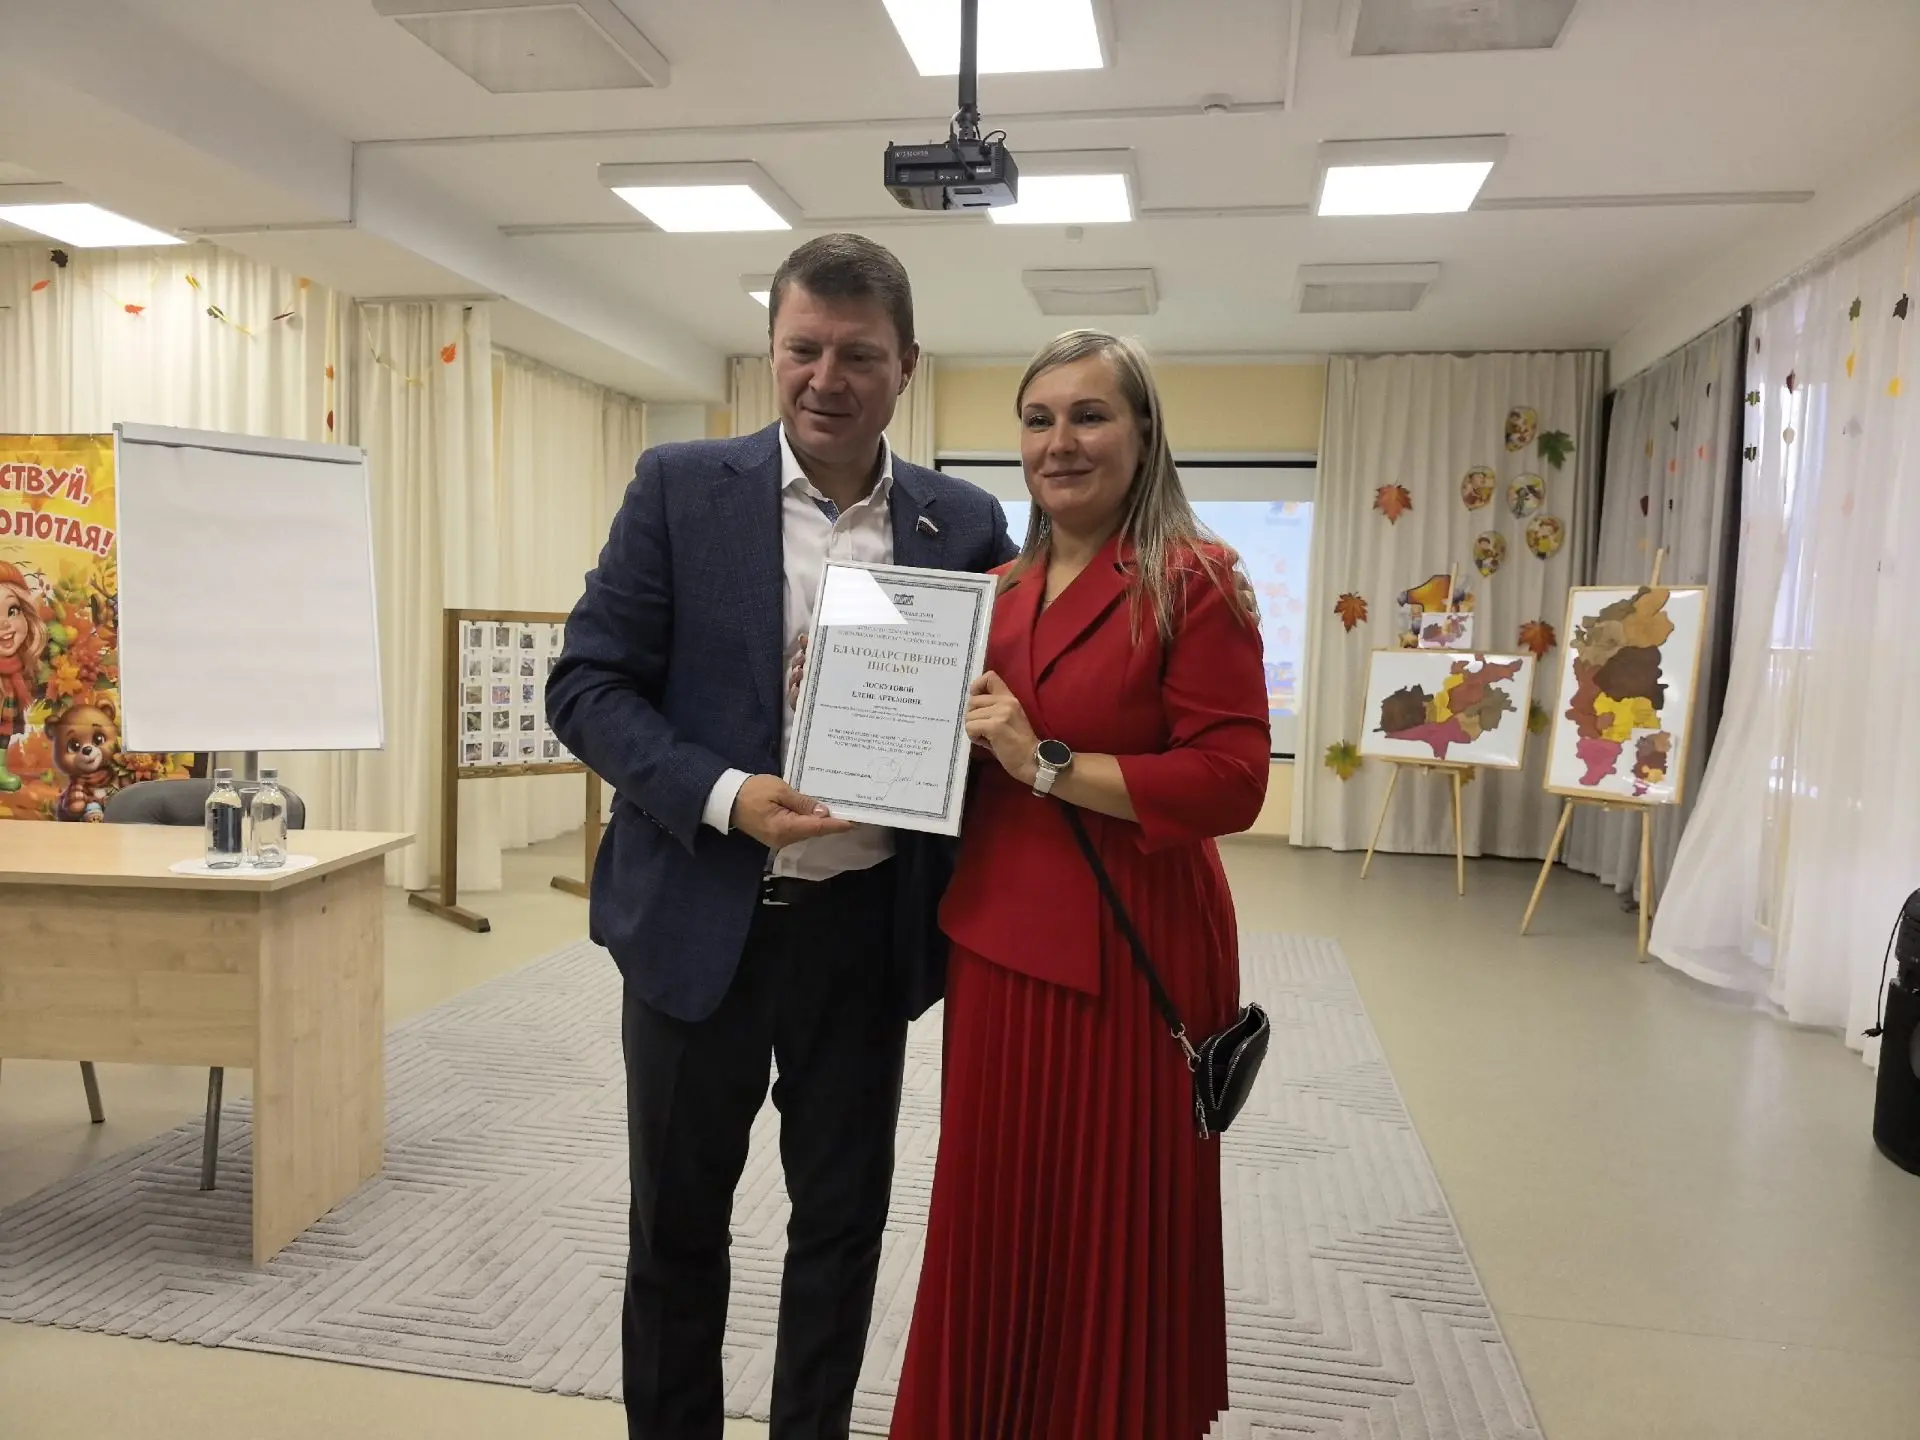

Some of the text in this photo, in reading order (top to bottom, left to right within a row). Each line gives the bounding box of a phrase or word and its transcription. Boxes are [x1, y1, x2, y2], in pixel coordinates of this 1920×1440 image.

[0, 464, 90, 505] СТВУЙ,
[0, 509, 114, 555] ОЛОТАЯ!
[832, 644, 958, 667] БЛАГОДАРСТВЕННОЕ
[867, 661, 919, 675] ПИСЬМО
